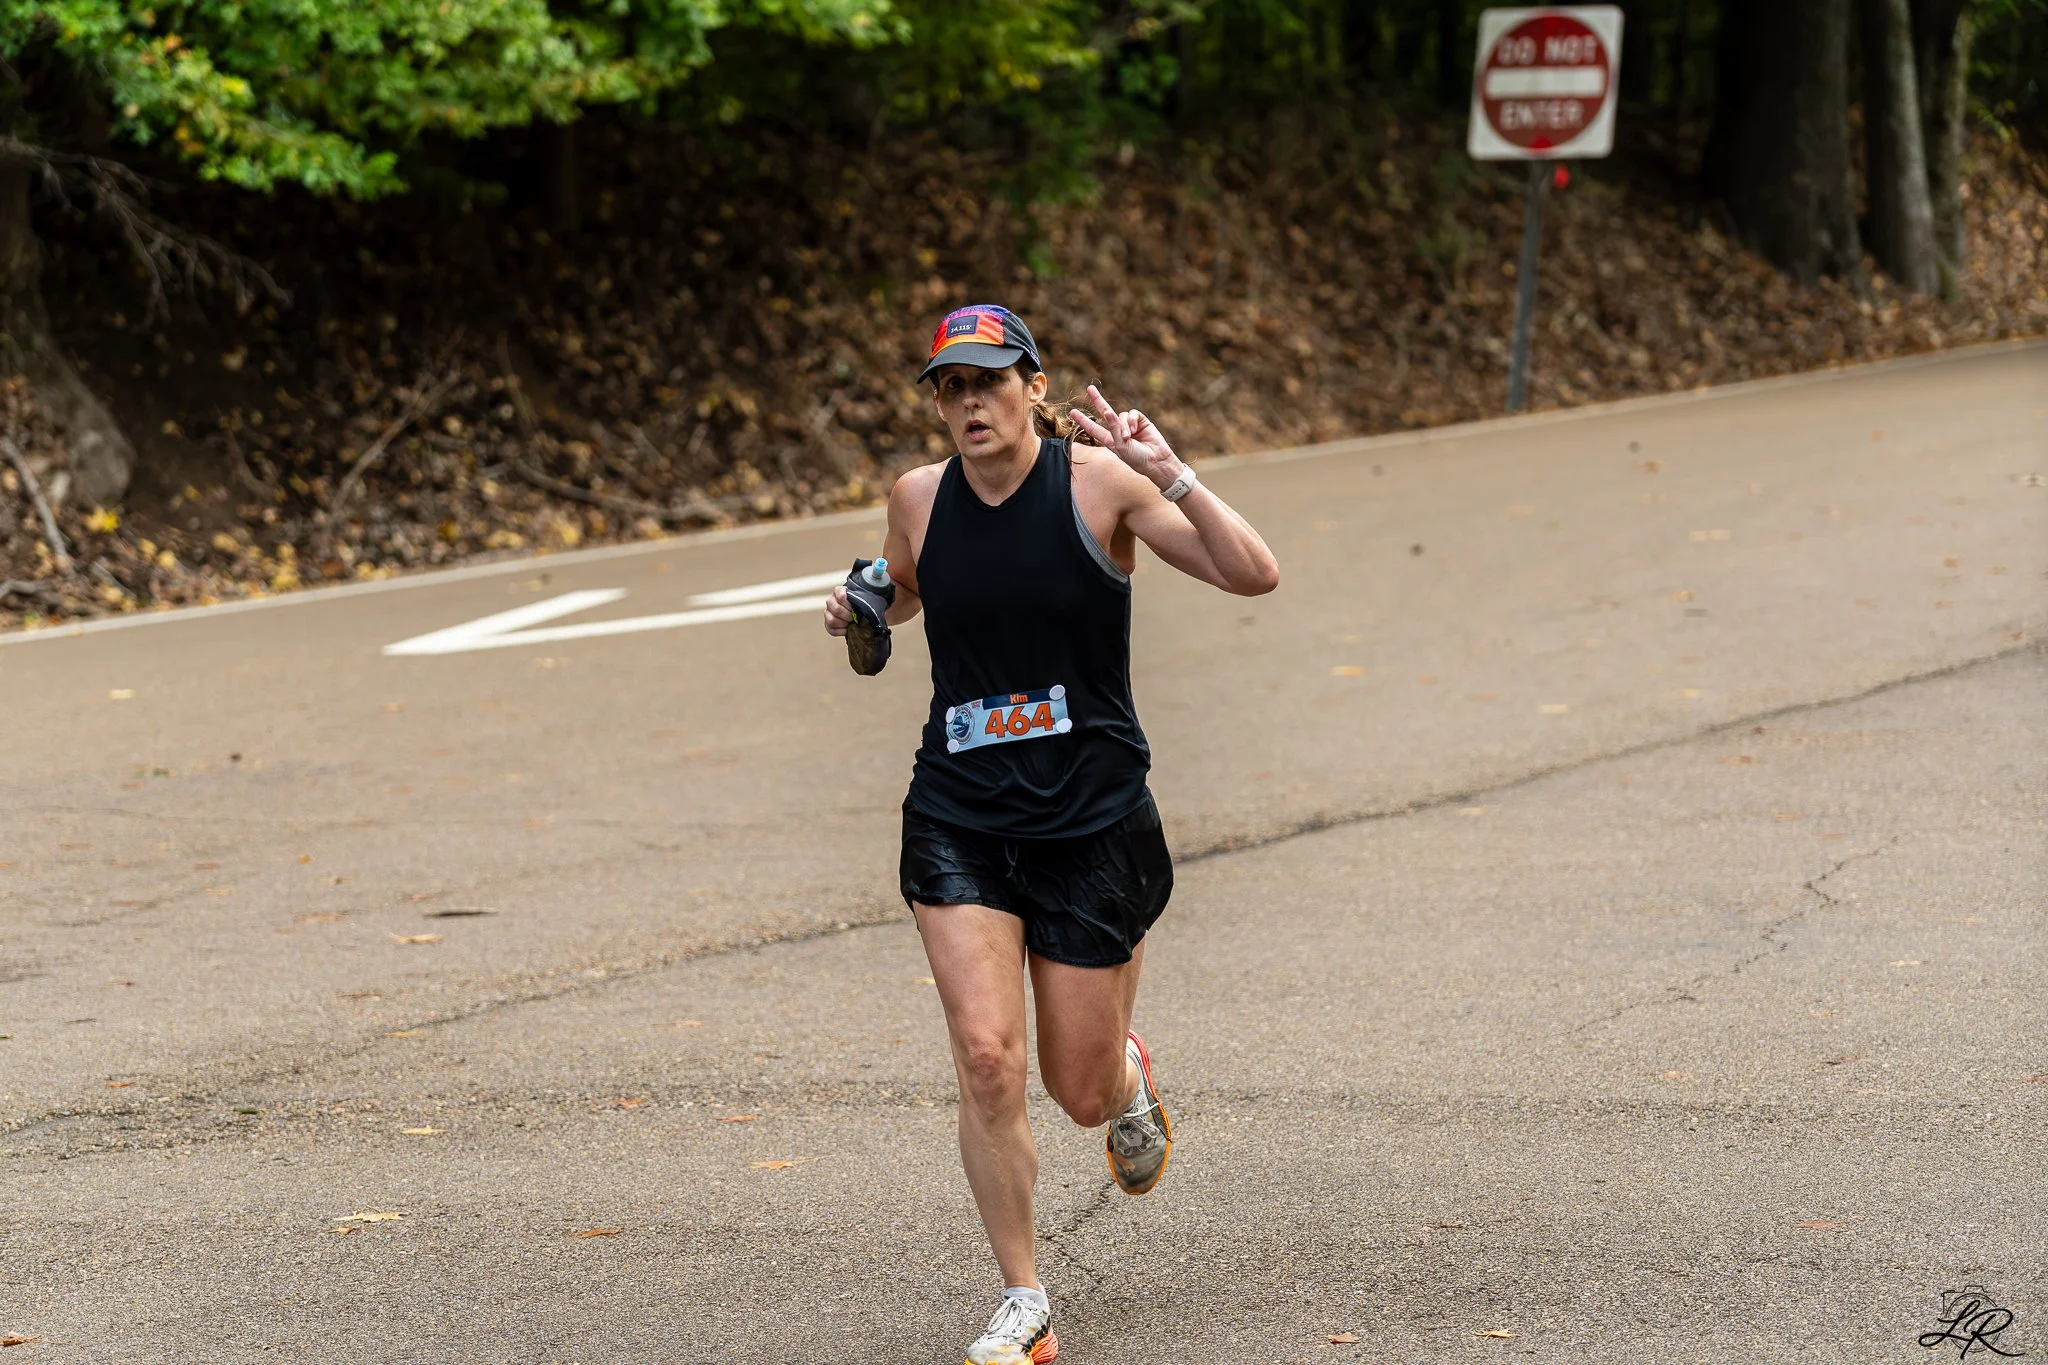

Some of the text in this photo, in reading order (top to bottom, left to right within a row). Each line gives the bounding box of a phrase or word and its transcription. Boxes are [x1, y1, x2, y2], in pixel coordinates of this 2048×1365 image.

[1498, 34, 1597, 65] DO NOT
[1501, 100, 1583, 129] ENTER
[1009, 693, 1028, 704] Kim
[985, 702, 1055, 738] 464
